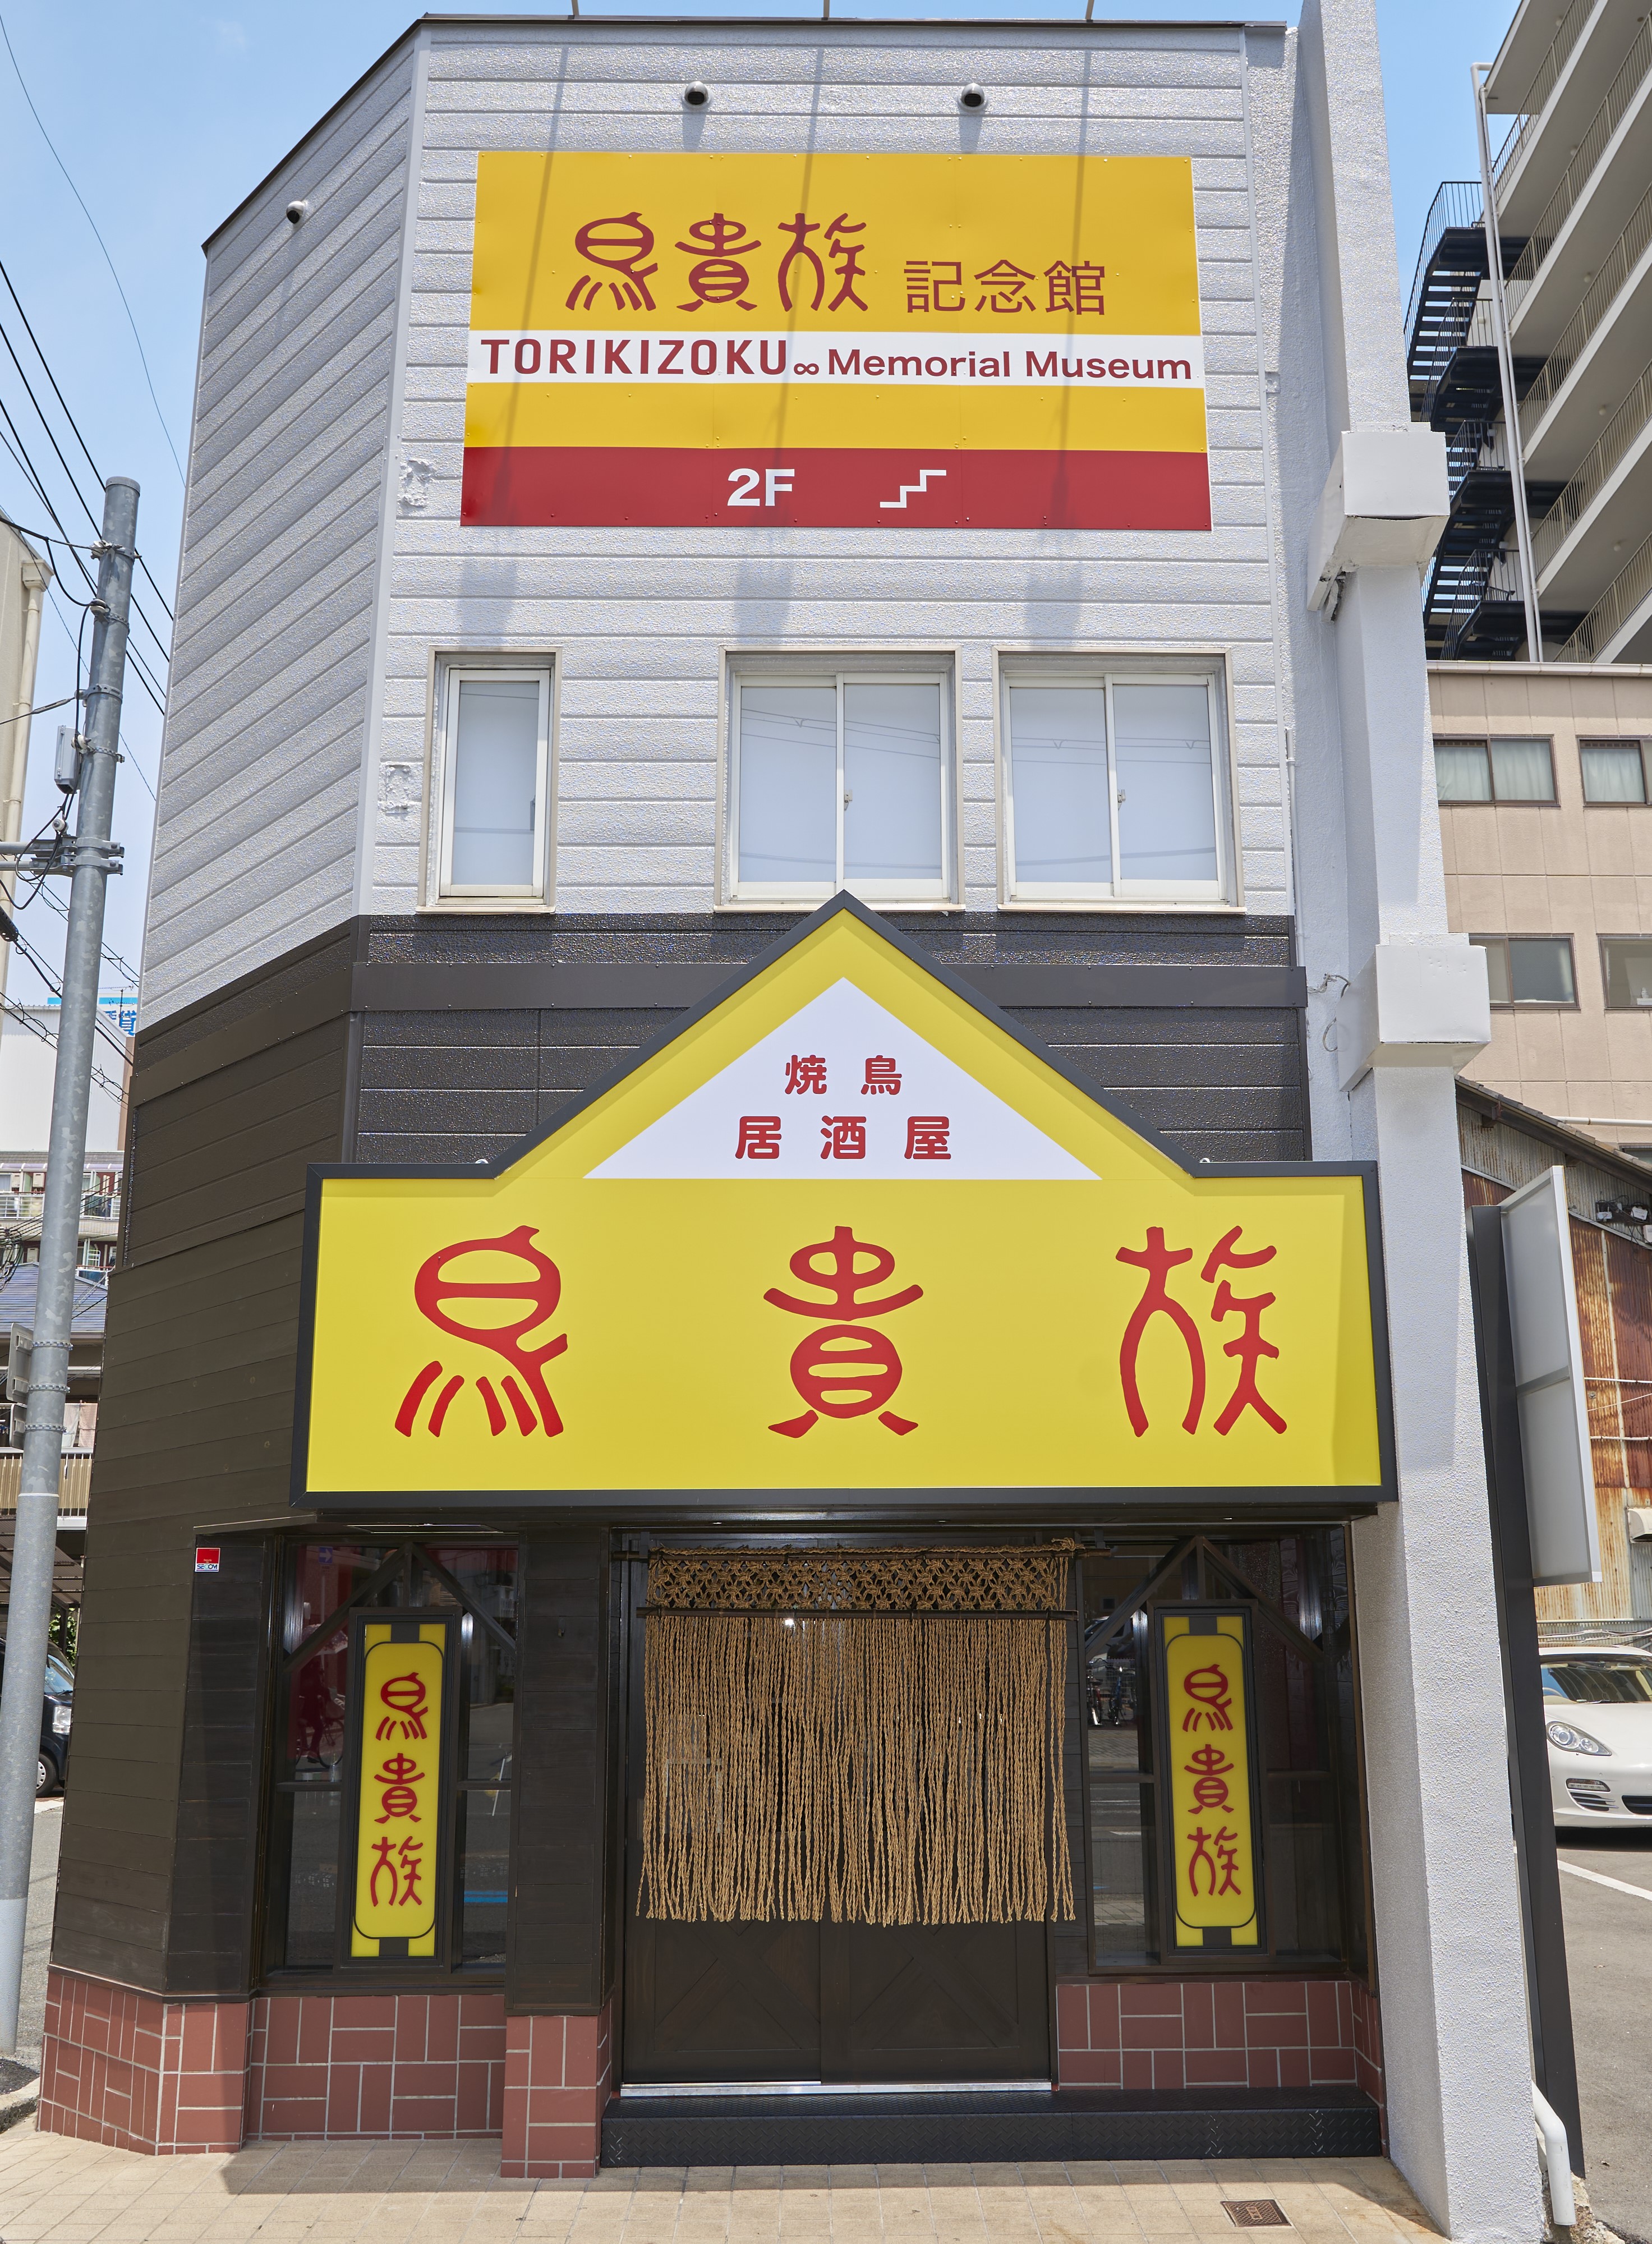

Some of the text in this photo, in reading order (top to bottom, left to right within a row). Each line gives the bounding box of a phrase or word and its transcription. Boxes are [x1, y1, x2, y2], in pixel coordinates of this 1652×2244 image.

[565, 211, 1106, 315] 鳥貴族 記念館
[829, 348, 1010, 378] Memorial
[1026, 350, 1192, 380] Museum
[727, 467, 795, 507] 2F
[785, 1055, 902, 1095] 焼鳥
[735, 1115, 951, 1160] 居酒屋
[394, 1225, 1287, 1438] 鳥貴族
[370, 1672, 429, 1907] 鳥貴族
[1182, 1664, 1241, 1897] 鳥貴族
